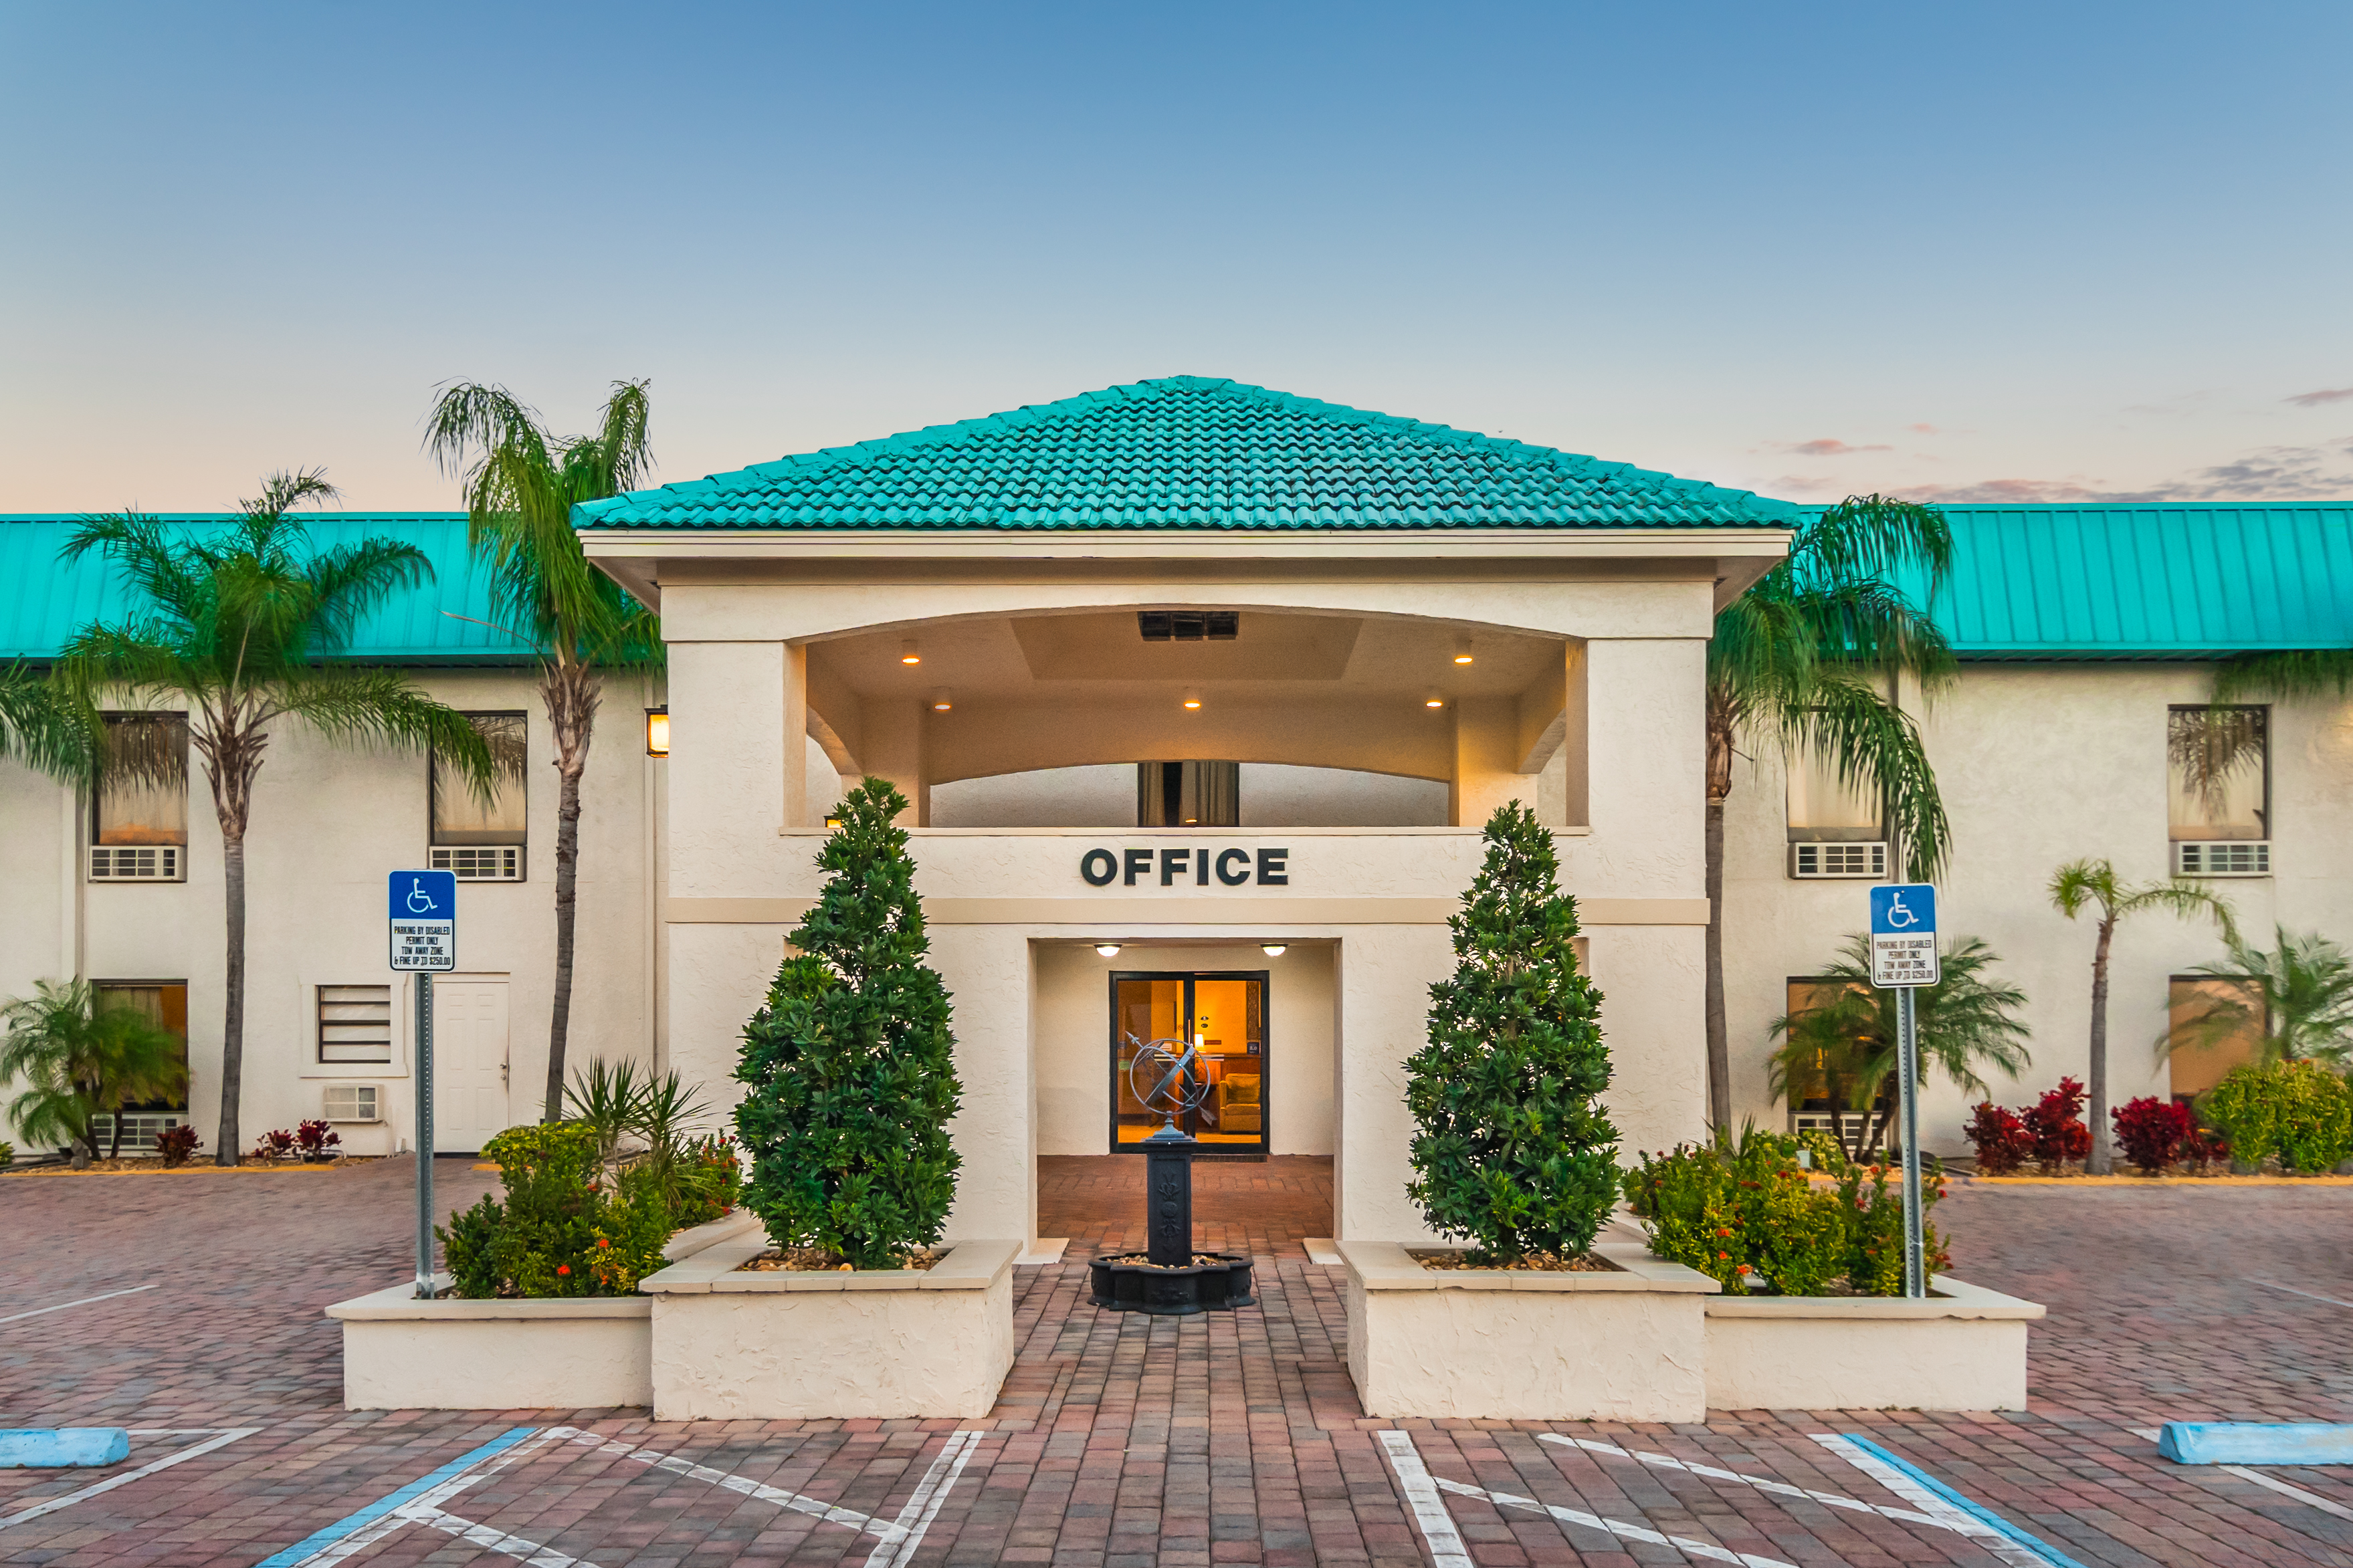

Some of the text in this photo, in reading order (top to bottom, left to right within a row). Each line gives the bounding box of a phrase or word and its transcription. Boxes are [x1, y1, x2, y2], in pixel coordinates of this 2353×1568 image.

[1081, 847, 1288, 886] OFFICE
[395, 926, 450, 935] PARKING BY DISABLED
[406, 936, 439, 945] PERMIT ONLY
[1877, 940, 1932, 949] PARKING BY DISABLED
[401, 946, 443, 955] TOW AWAY ZONE
[1888, 950, 1920, 959] PERMIT ONLY
[399, 956, 411, 964] FINE
[429, 957, 450, 965] $250.00
[1884, 960, 1926, 970] TOW AWAY ZONE
[1883, 972, 1894, 980] FINE
[1896, 971, 1902, 979] UP
[1904, 971, 1910, 979] TO
[1912, 970, 1933, 978] $250.00
